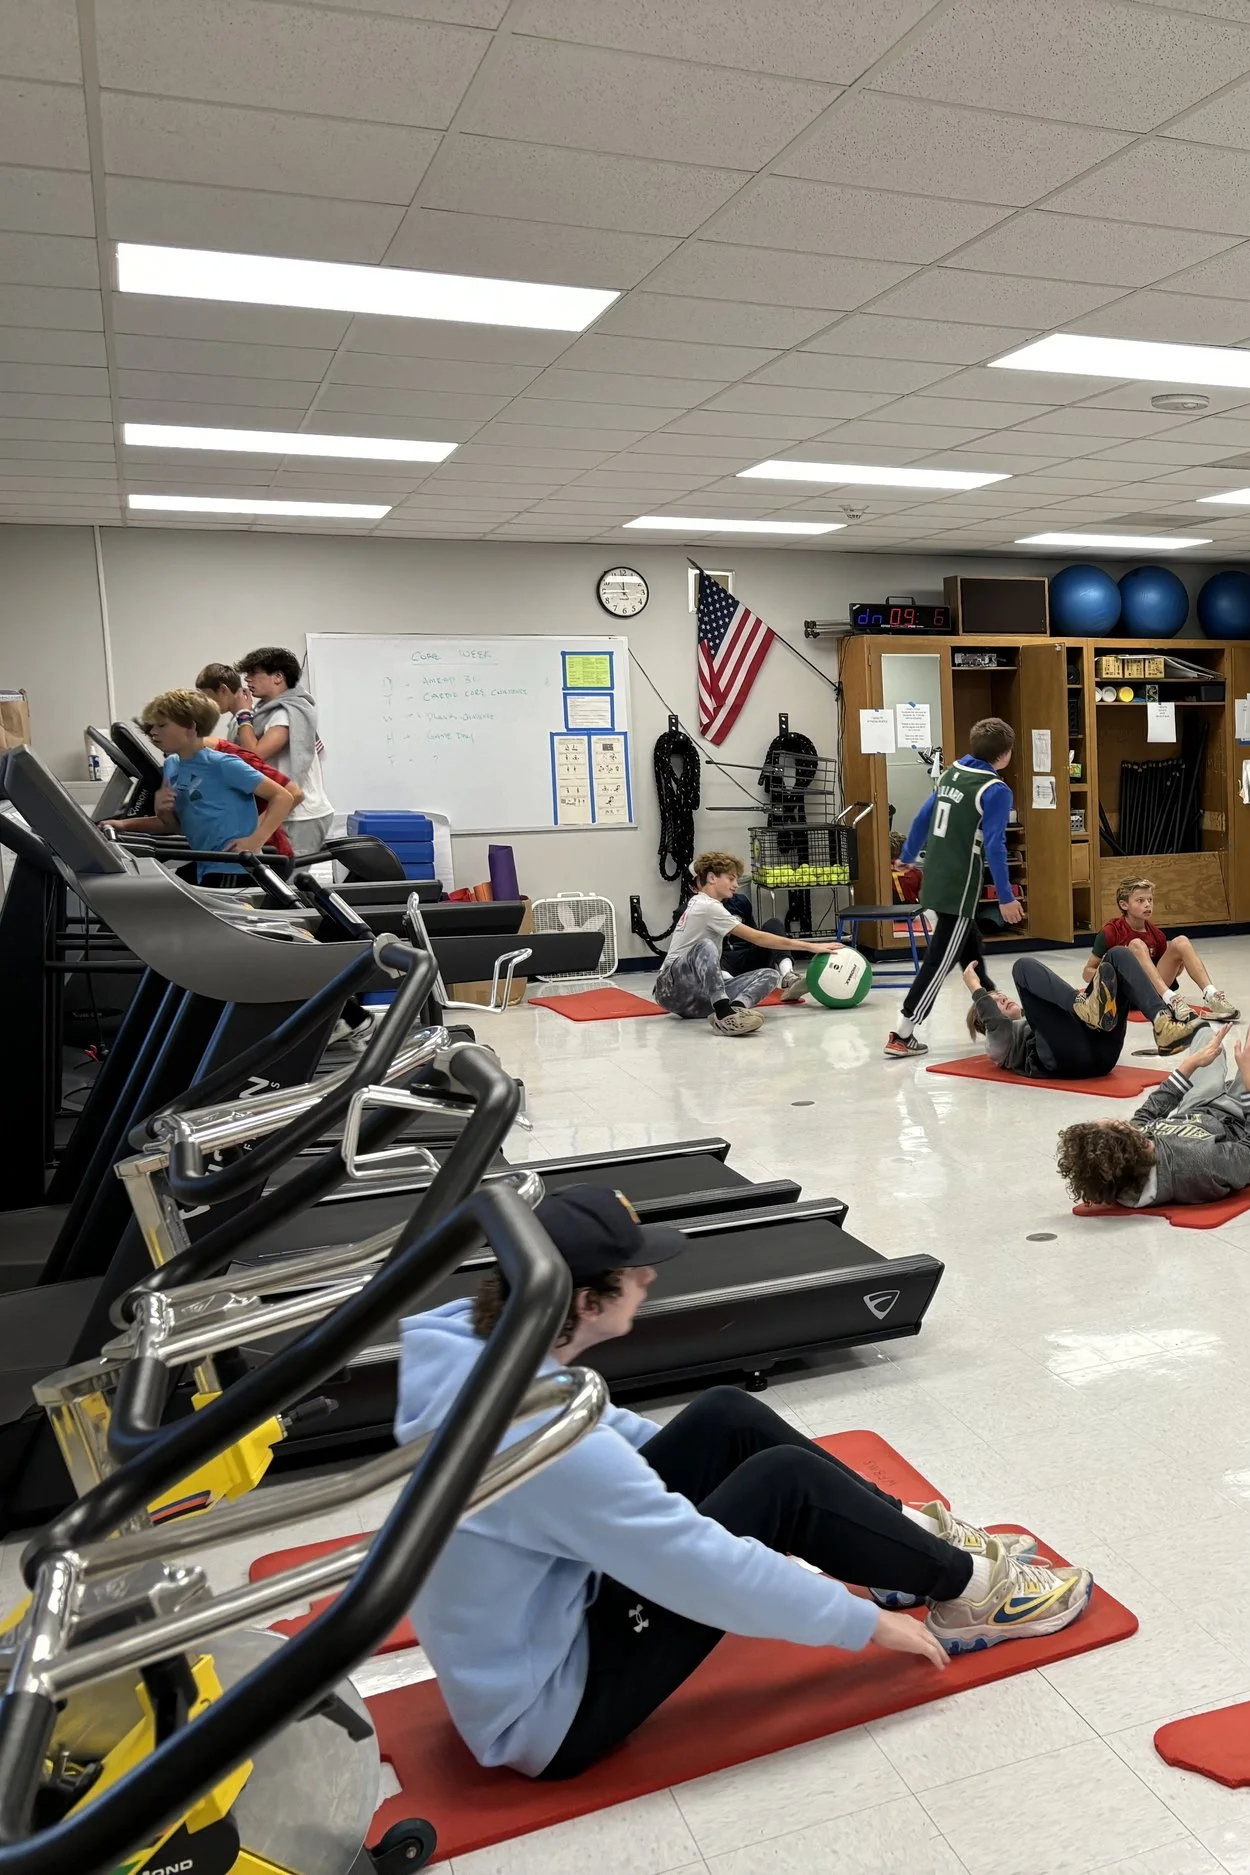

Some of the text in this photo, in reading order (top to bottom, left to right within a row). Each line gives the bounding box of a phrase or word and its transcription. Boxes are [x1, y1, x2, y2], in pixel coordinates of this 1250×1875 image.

[605, 597, 610, 605] 8
[411, 649, 492, 662] CORE WEEK
[933, 800, 952, 839] 0
